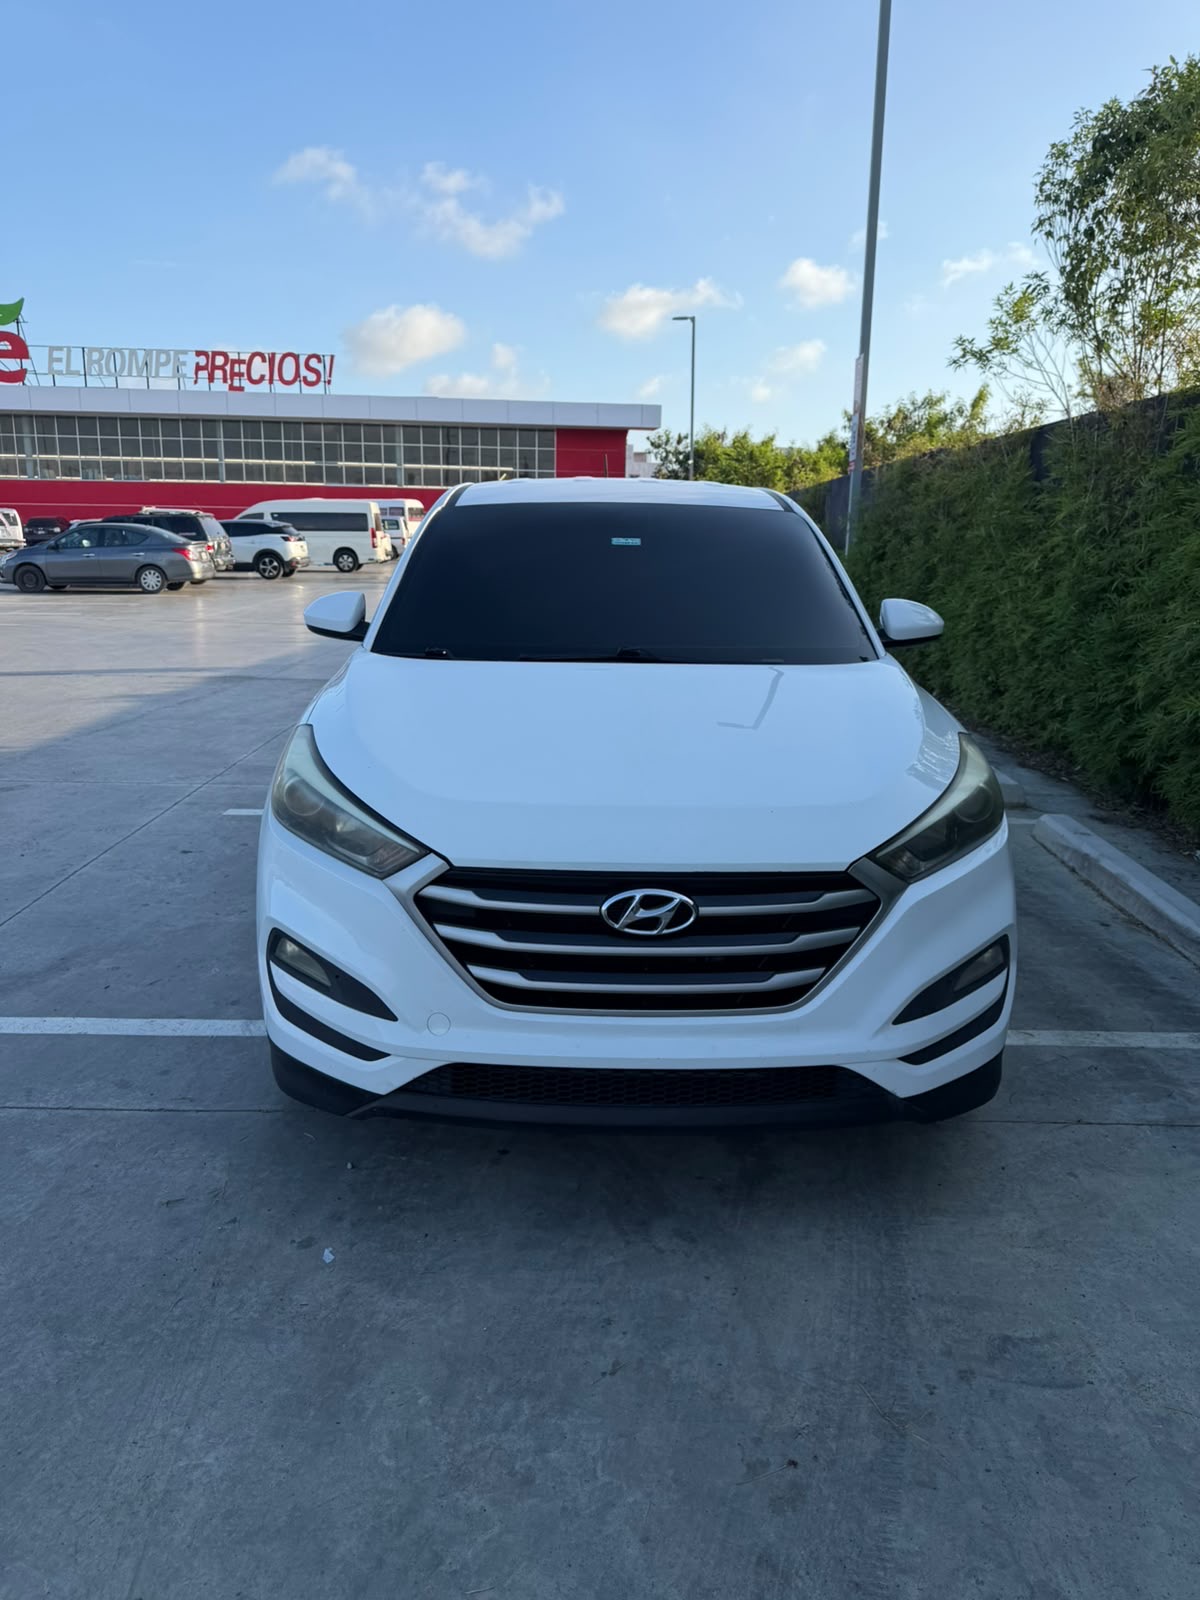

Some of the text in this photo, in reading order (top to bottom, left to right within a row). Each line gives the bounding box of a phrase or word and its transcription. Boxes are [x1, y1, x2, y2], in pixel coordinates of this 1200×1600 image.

[48, 346, 335, 391] EL ROMPE PRECIOS!
